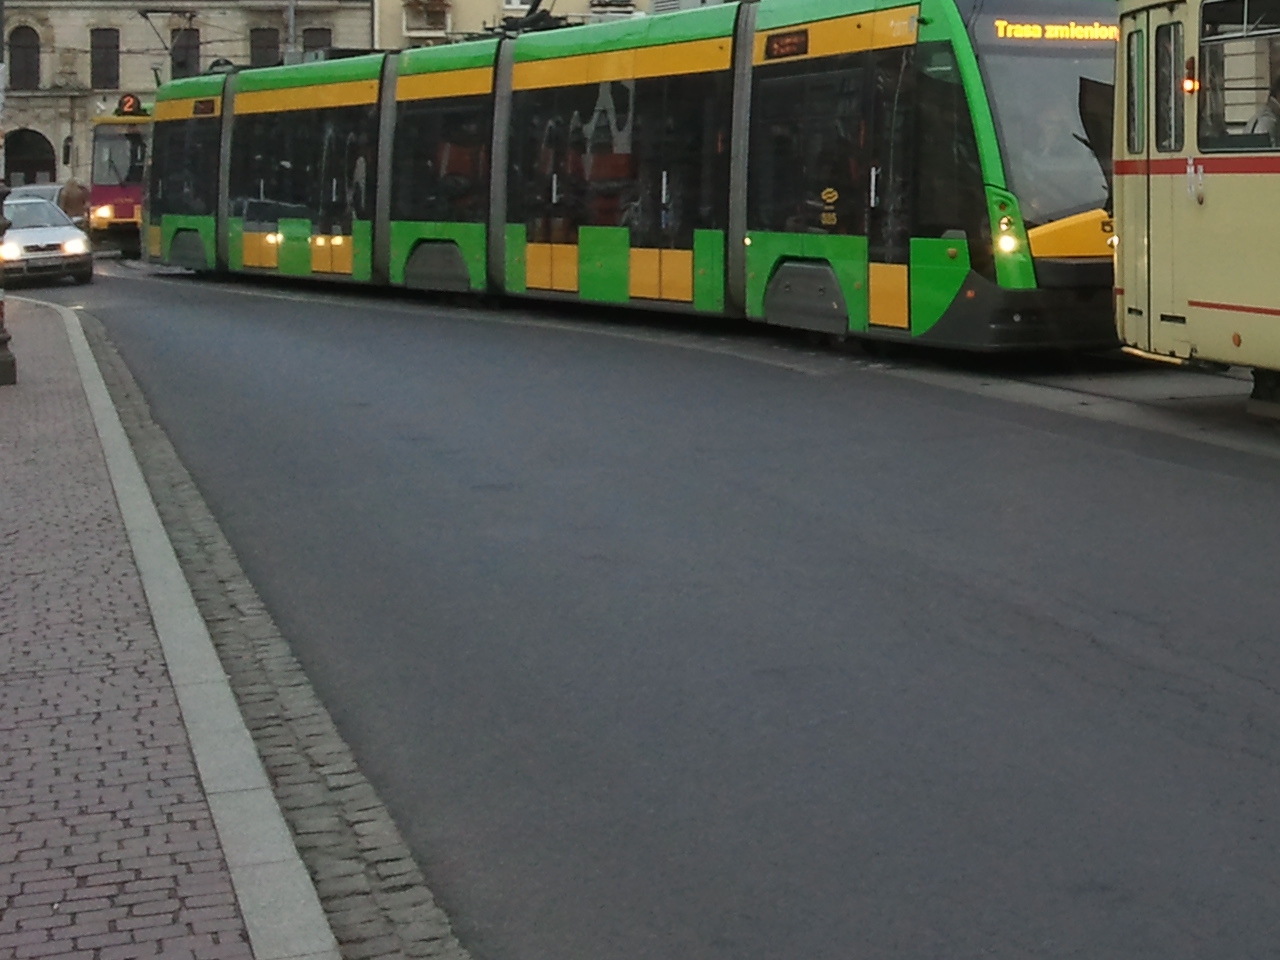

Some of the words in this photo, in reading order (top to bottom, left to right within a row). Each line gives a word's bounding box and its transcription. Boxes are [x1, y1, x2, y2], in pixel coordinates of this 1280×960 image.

[994, 19, 1042, 38] Trasa
[1044, 21, 1120, 40] zmienion
[123, 96, 134, 112] 2
